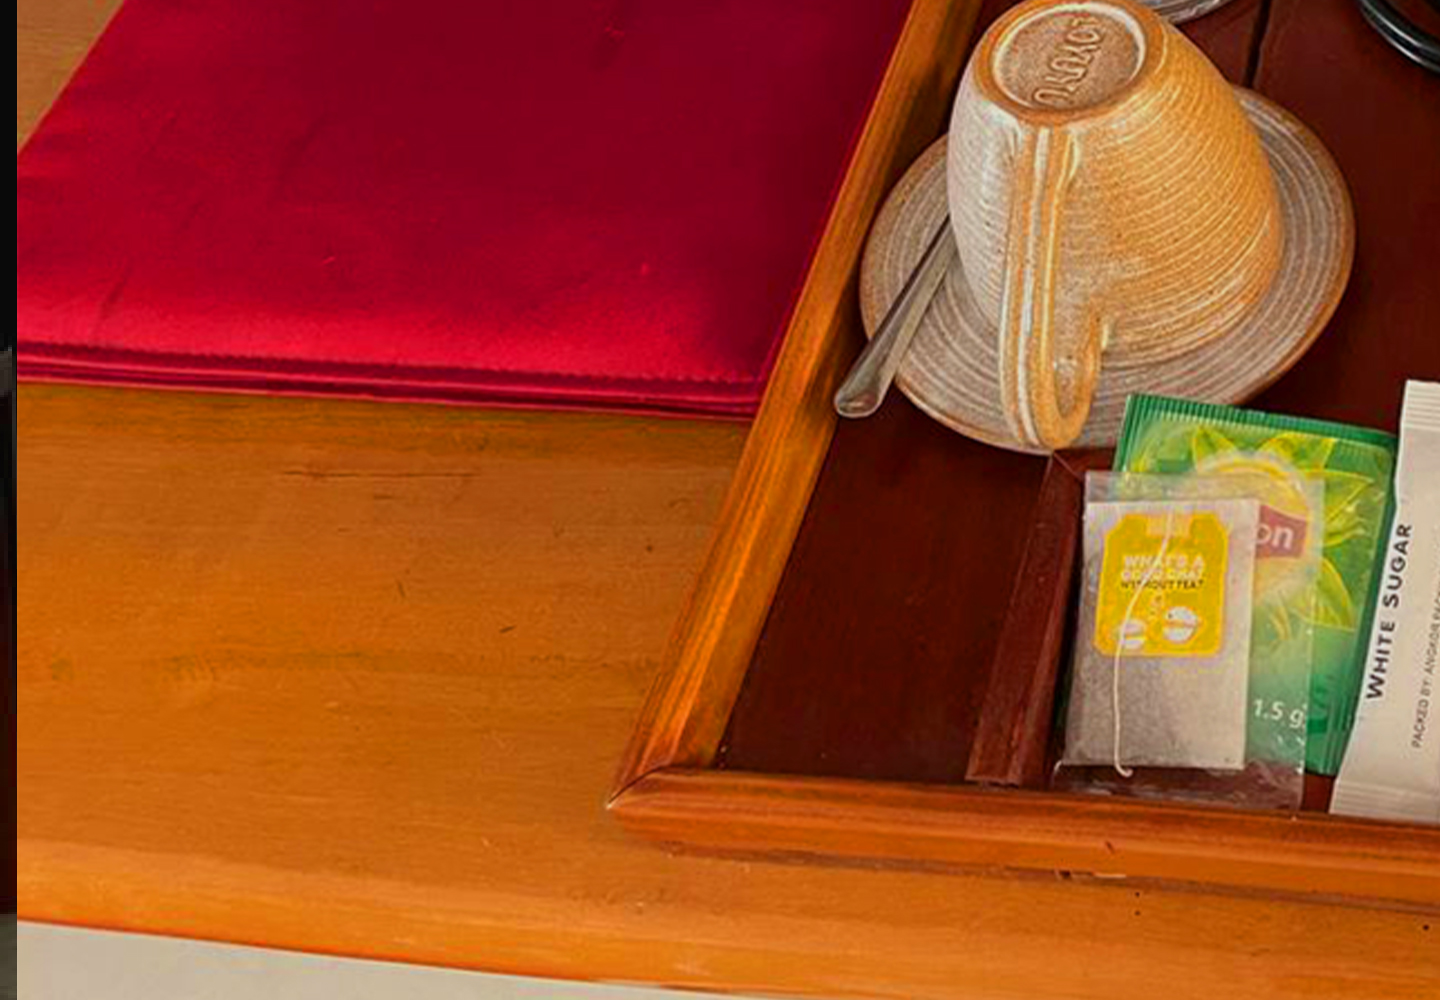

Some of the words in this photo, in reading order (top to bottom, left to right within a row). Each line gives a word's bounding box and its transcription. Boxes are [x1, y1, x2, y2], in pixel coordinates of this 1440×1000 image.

[1366, 620, 1396, 699] WHITE
[1382, 523, 1412, 608] SUGAR
[1254, 699, 1284, 721] 1.5
[1411, 699, 1429, 748] PACKED
